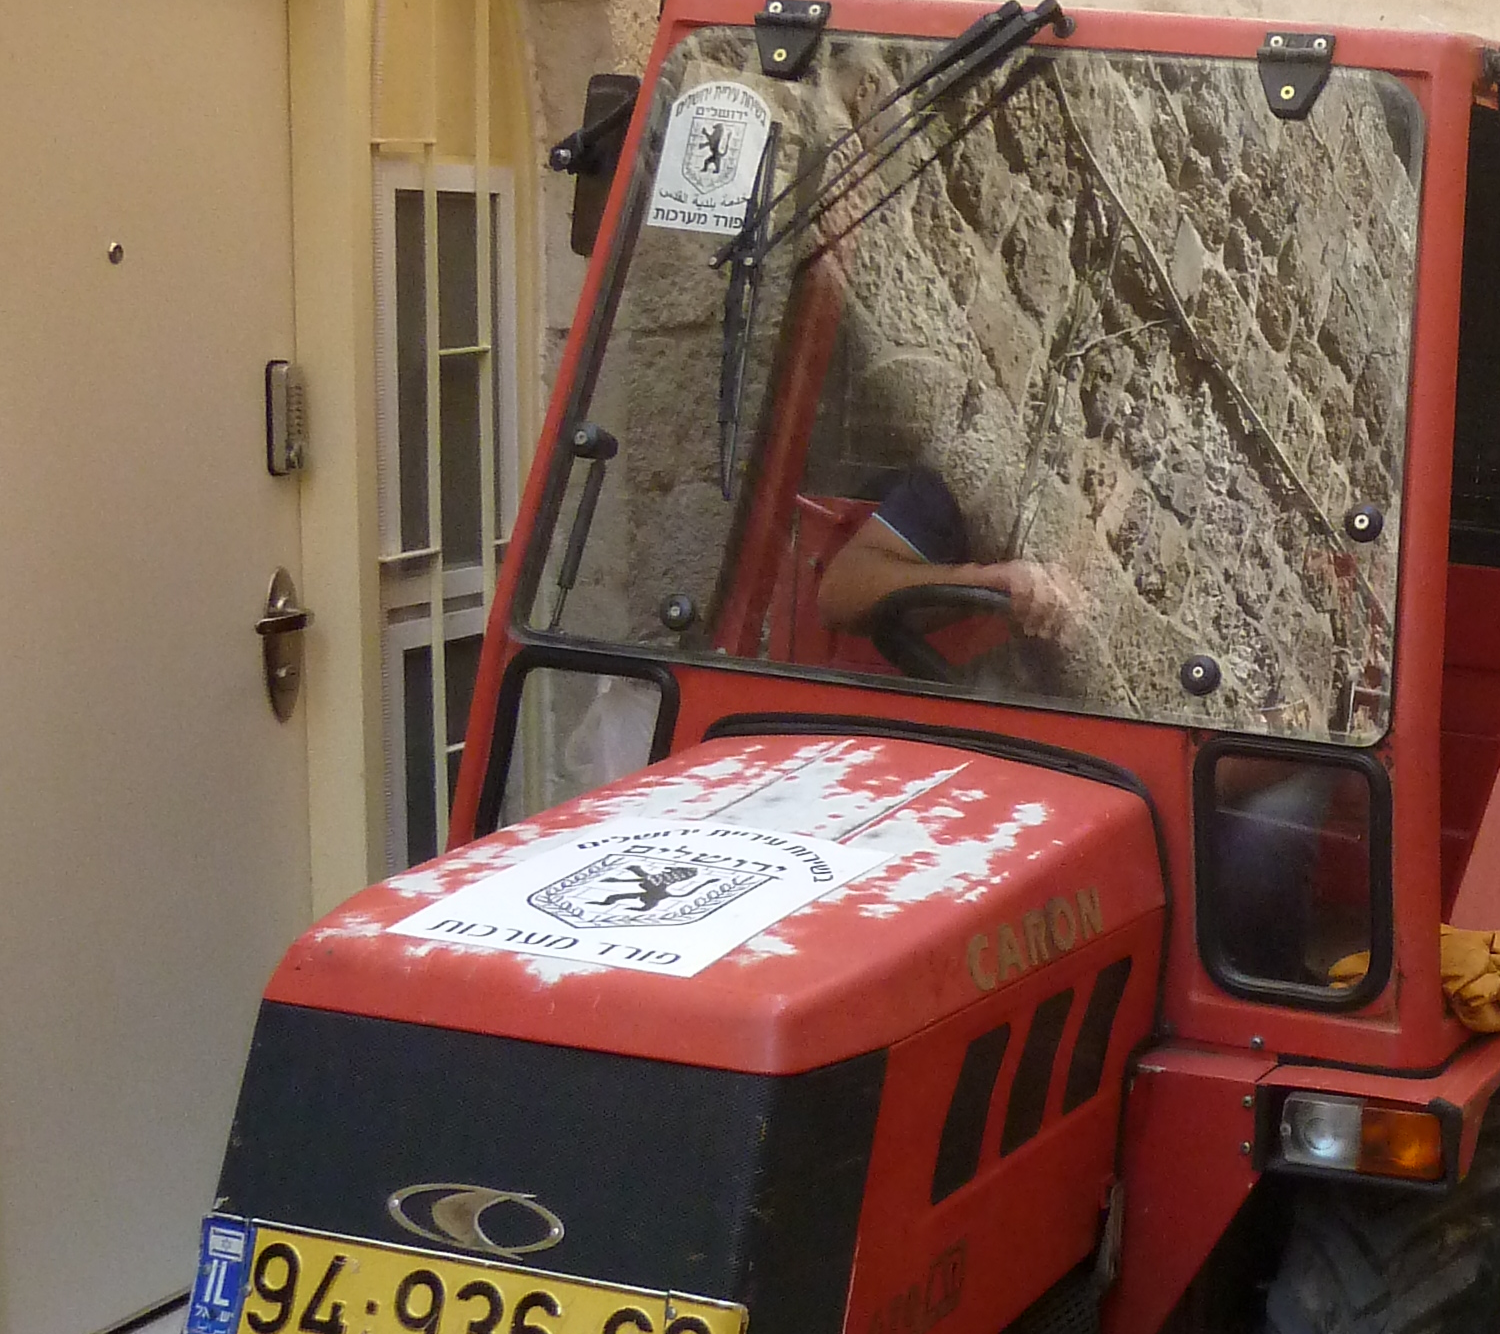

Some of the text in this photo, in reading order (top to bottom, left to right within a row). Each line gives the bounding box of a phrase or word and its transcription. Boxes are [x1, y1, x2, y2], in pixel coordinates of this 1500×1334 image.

[695, 106, 748, 120] ירושלים
[653, 207, 744, 229] פורד מערכות
[577, 828, 834, 883] בשירות עיריית ירושלים
[622, 845, 787, 872] ירושלים
[426, 919, 682, 965] פורד מערכות
[966, 886, 1103, 992] CARON
[204, 1258, 230, 1307] IL
